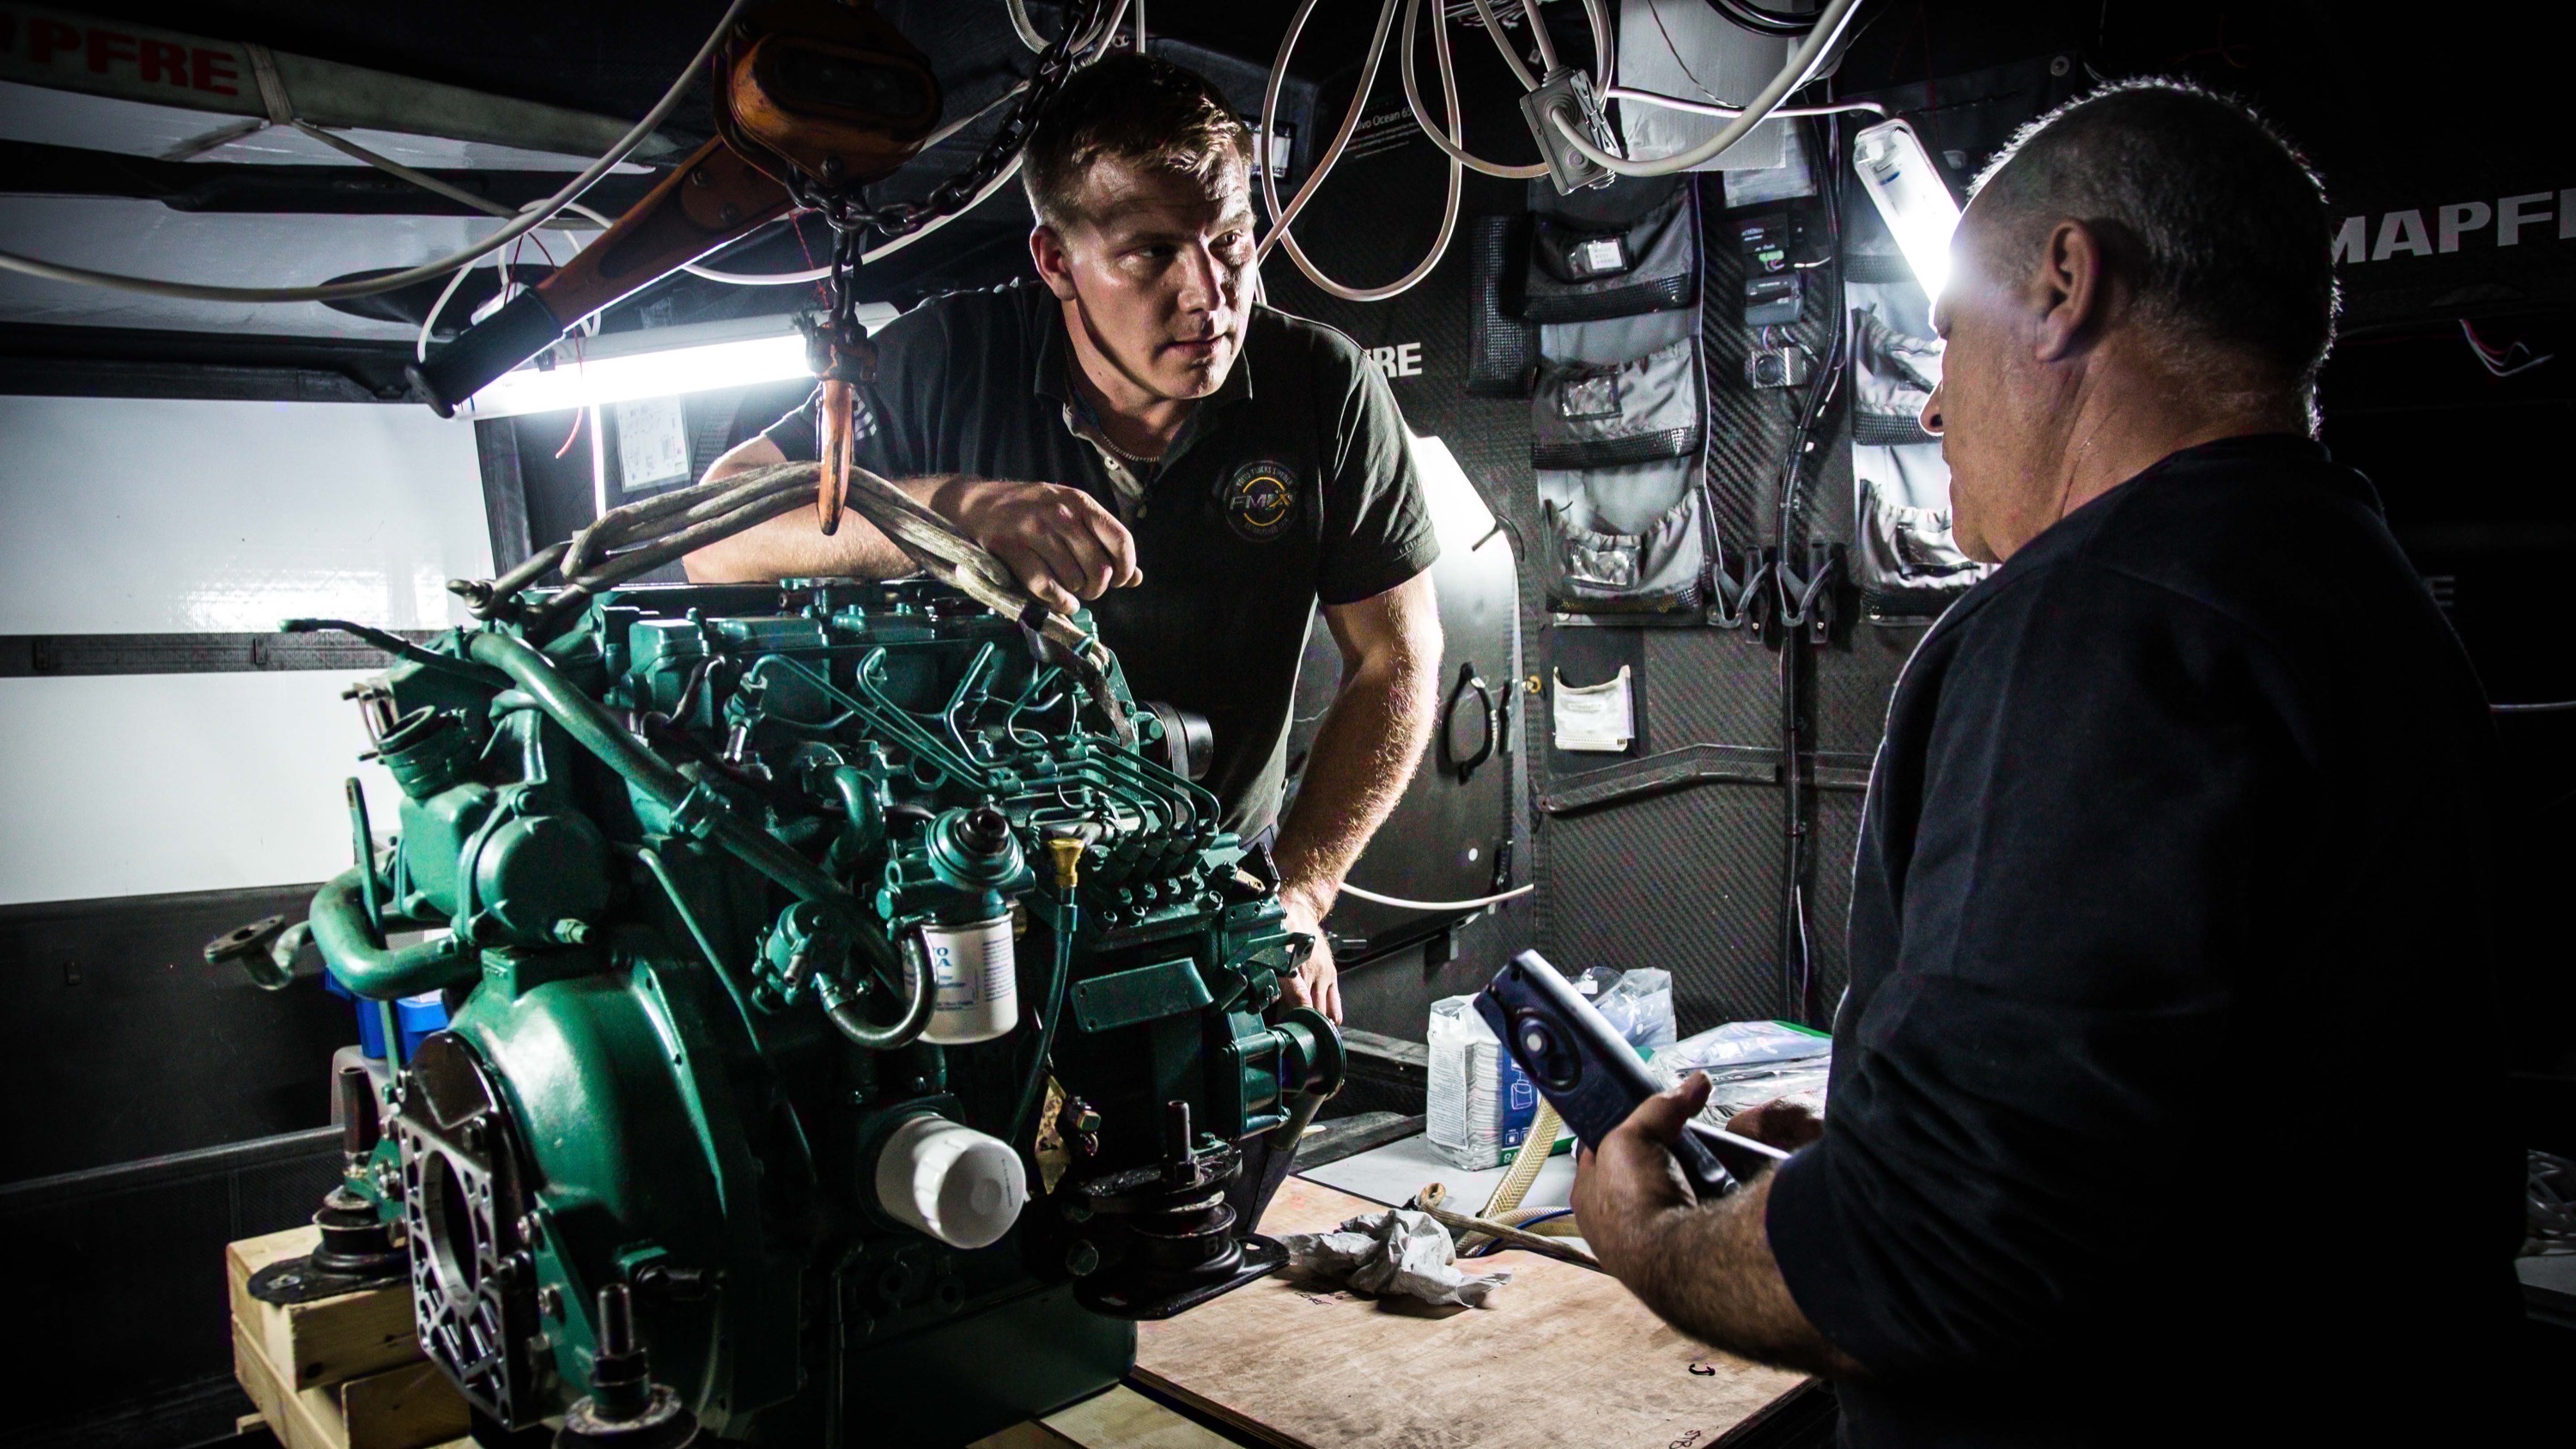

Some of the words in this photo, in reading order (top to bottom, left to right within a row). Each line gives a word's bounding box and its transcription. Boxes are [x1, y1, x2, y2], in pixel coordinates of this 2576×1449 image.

[0, 11, 238, 95] PFRE
[1373, 112, 1400, 126] Ocean
[1364, 342, 1423, 378] RE
